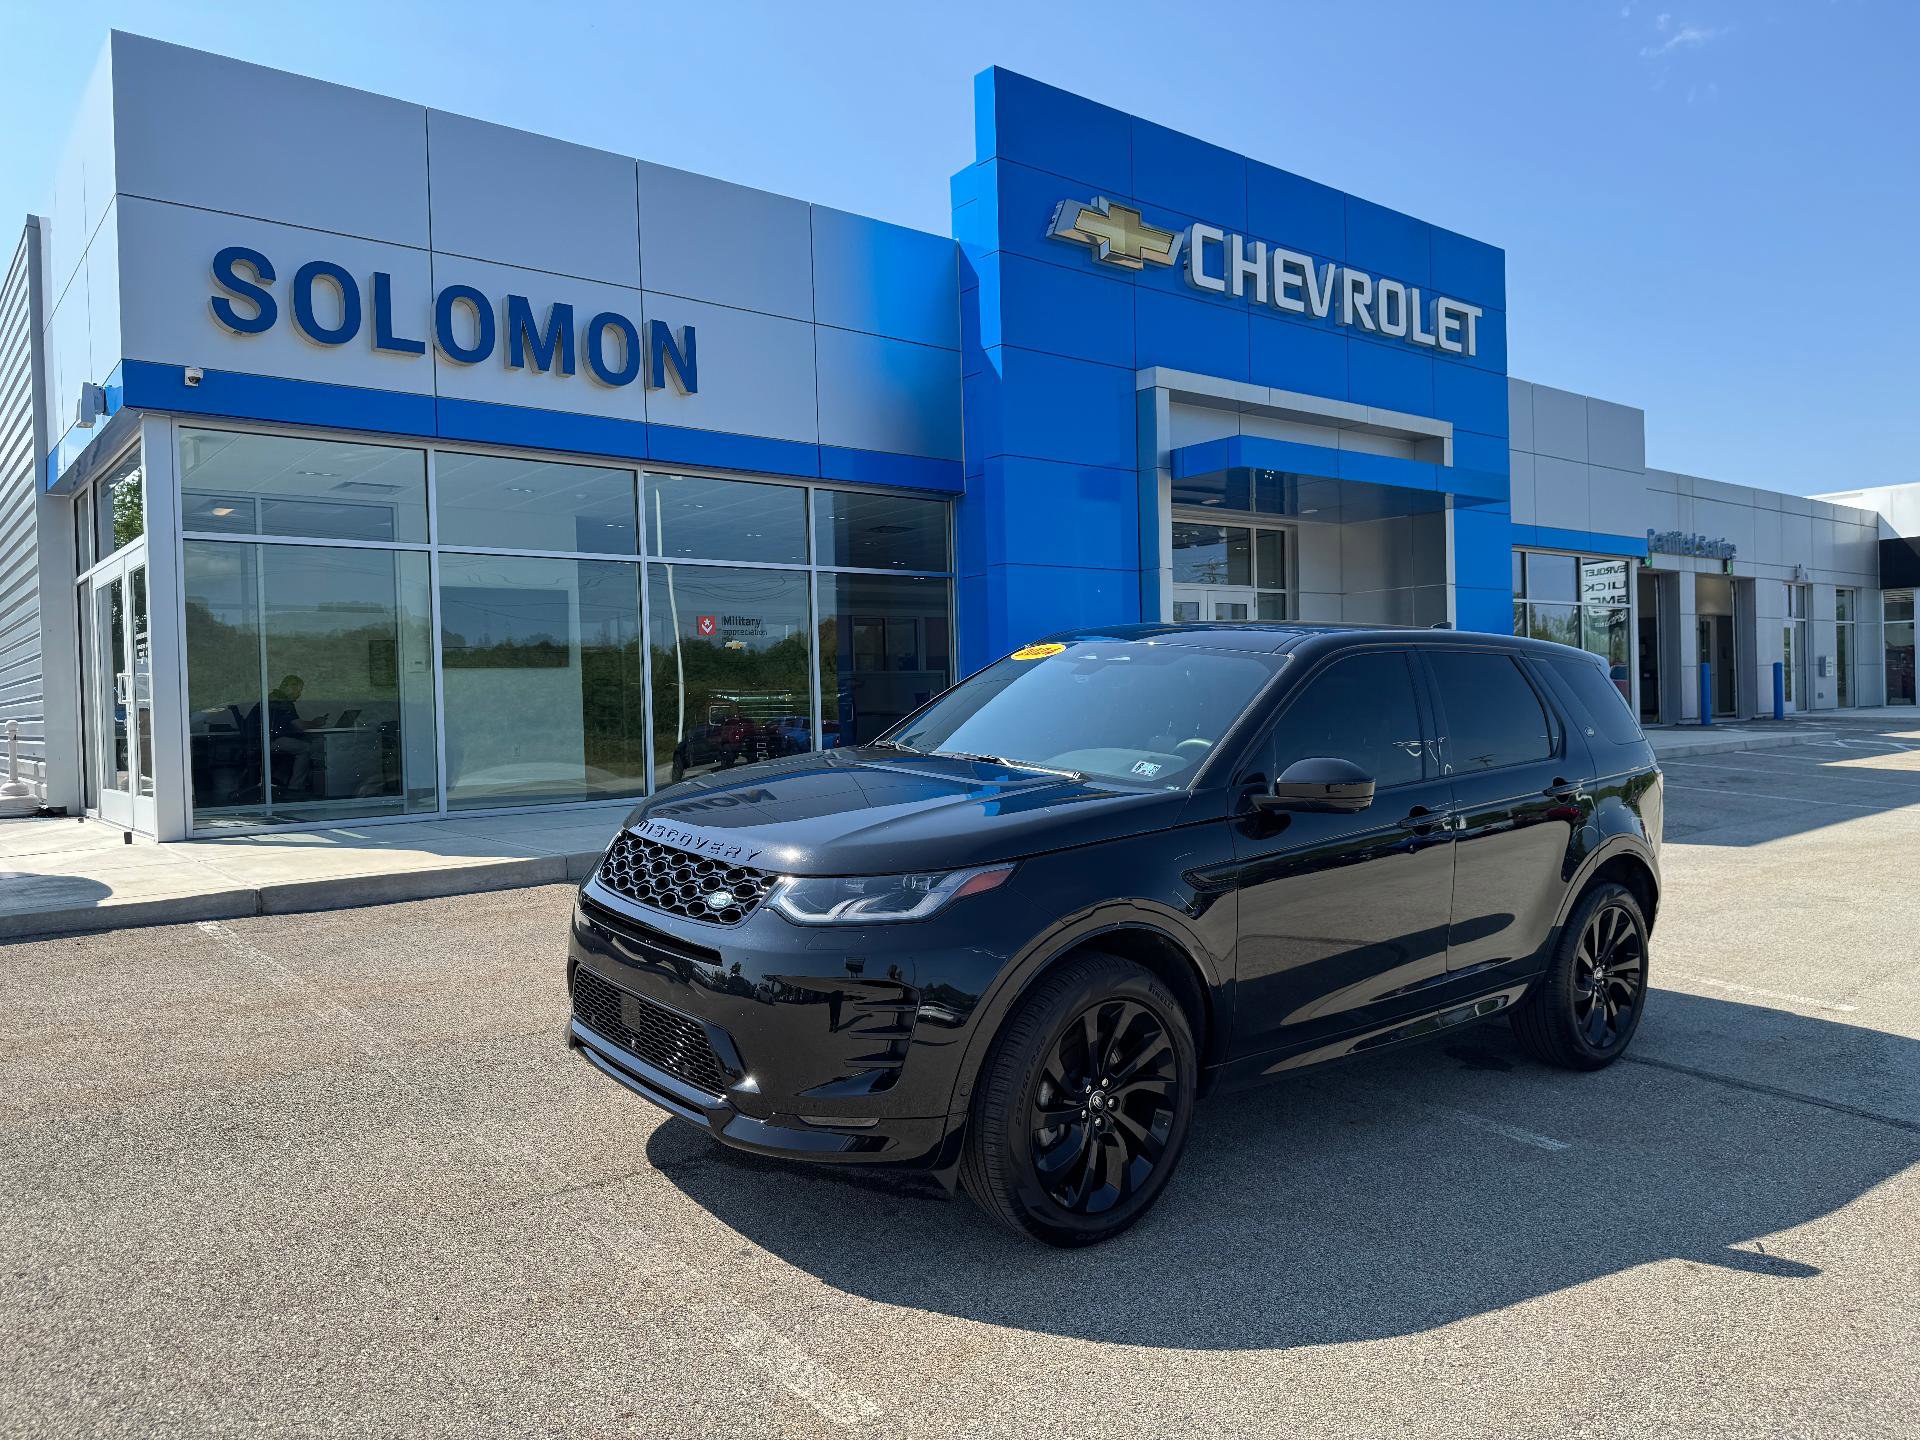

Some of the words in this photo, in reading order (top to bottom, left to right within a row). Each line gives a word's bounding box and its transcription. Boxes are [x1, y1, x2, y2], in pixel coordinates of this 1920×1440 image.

[209, 246, 699, 396] SOLOMON
[1184, 222, 1482, 357] CHEVROLET
[723, 615, 761, 628] Military
[637, 819, 763, 861] DISCOVERY
